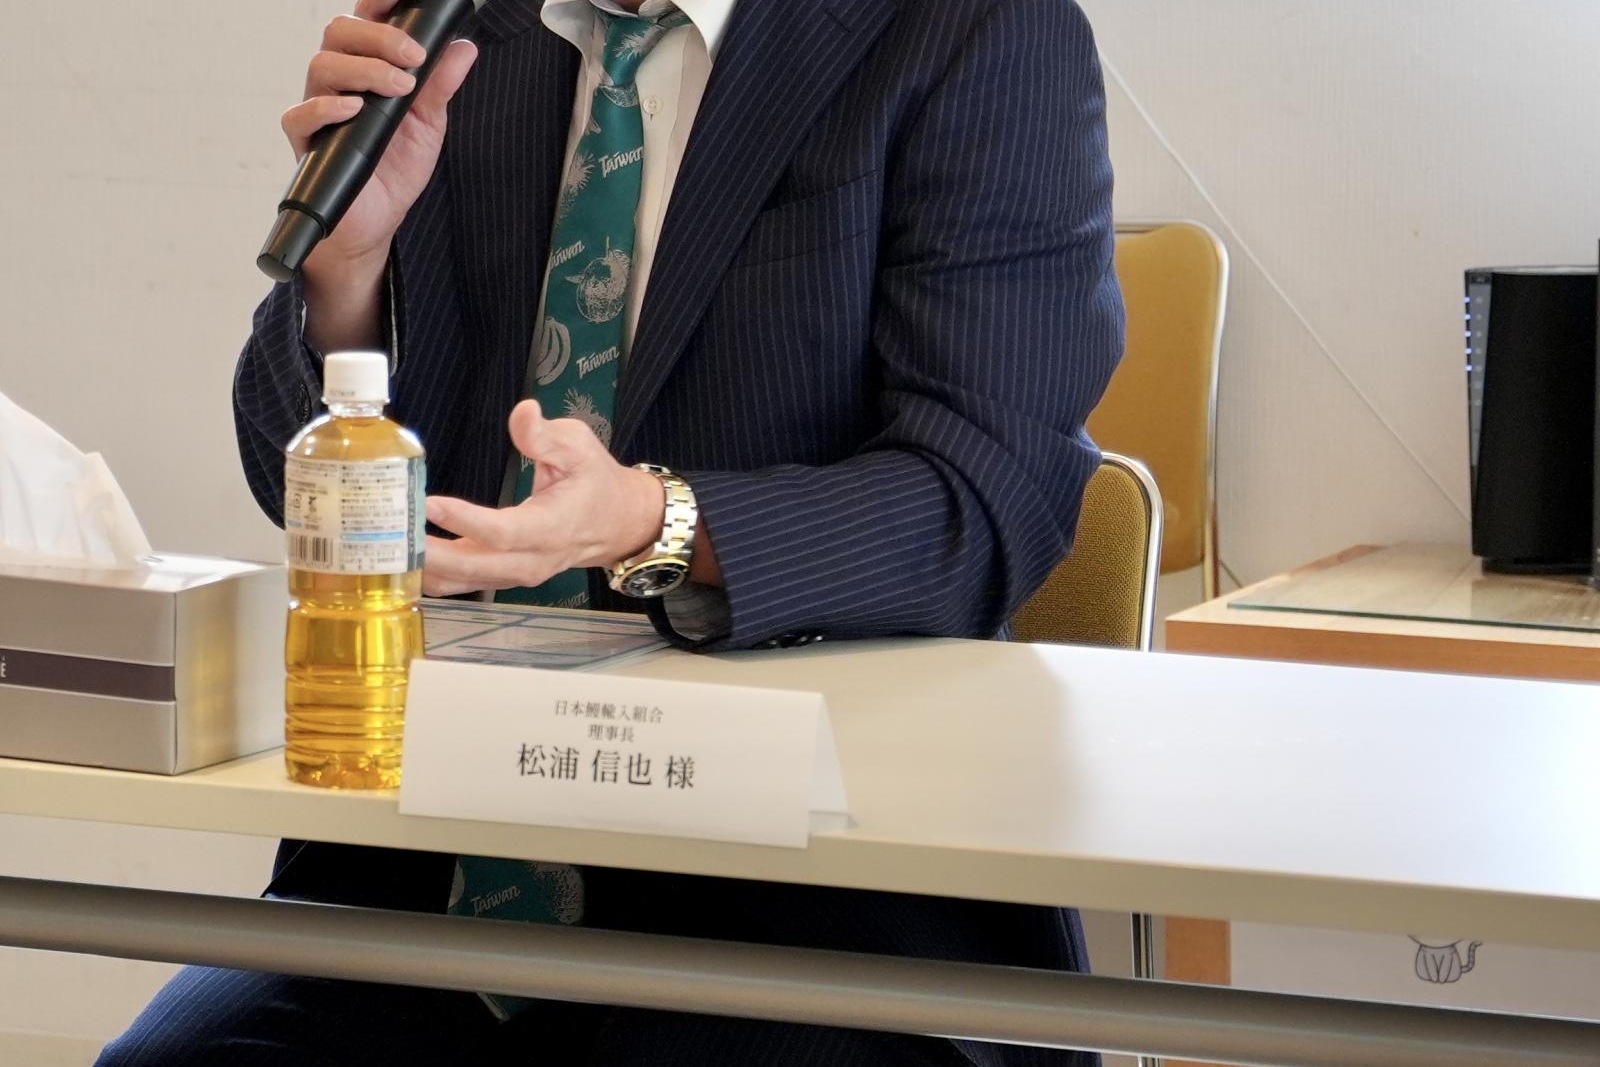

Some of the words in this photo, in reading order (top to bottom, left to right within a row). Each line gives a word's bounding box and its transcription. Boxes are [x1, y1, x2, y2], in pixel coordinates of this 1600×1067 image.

[576, 345, 620, 380] Taiwan
[587, 724, 635, 742] 理事長
[517, 743, 580, 780] 松浦
[592, 749, 653, 786] 信也
[664, 754, 696, 790] 様
[470, 886, 521, 917] Taiwan
